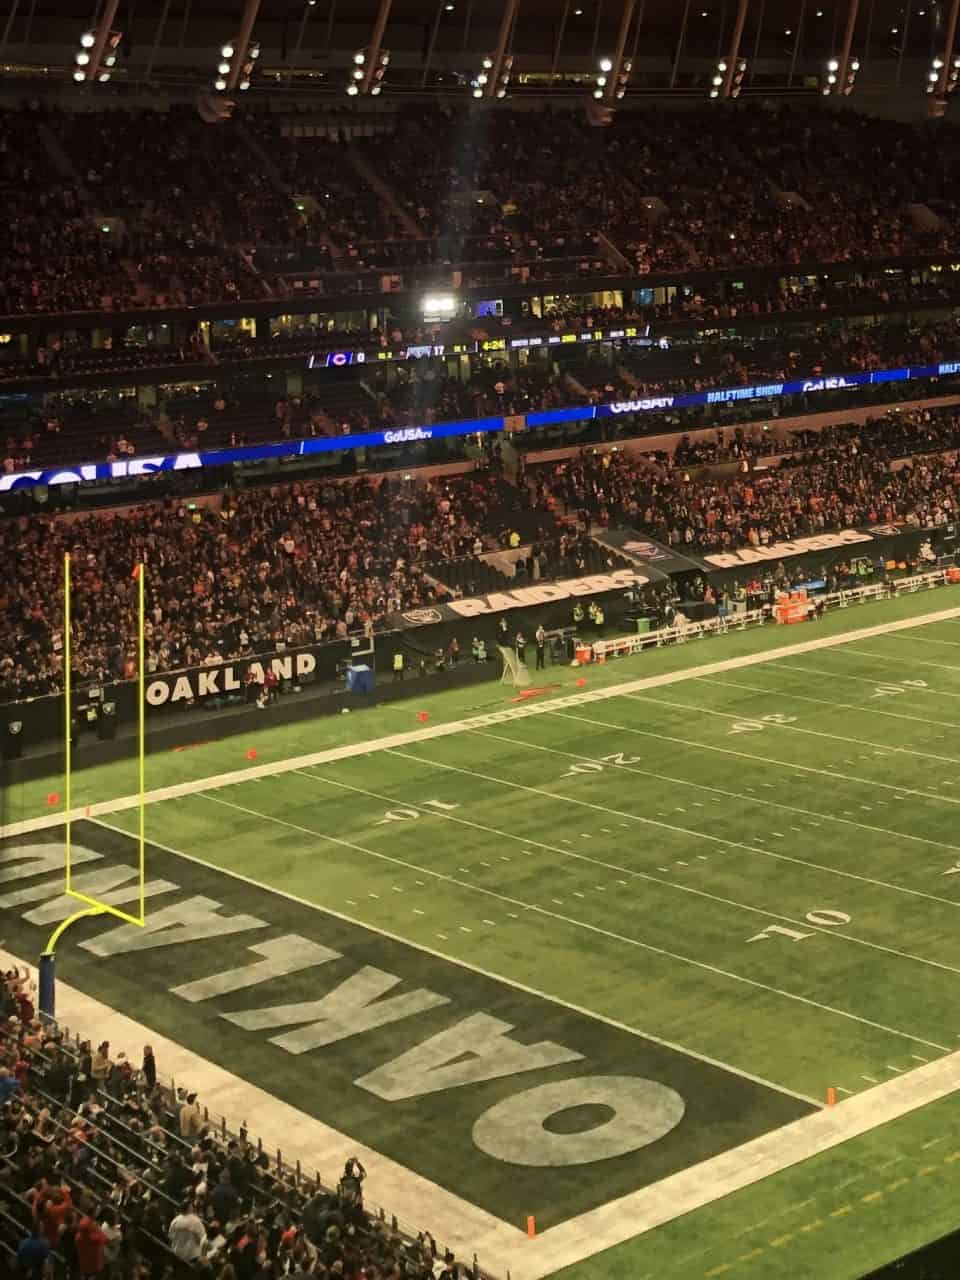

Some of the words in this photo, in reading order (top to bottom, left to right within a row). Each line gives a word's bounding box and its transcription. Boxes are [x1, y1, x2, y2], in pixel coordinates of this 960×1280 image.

[707, 387, 755, 403] HALFTIME
[756, 383, 784, 397] SHOW
[703, 529, 875, 569] RAIDERS
[447, 568, 650, 617] RAIDERS
[146, 653, 317, 705] OAKLAND
[760, 908, 852, 943] 10
